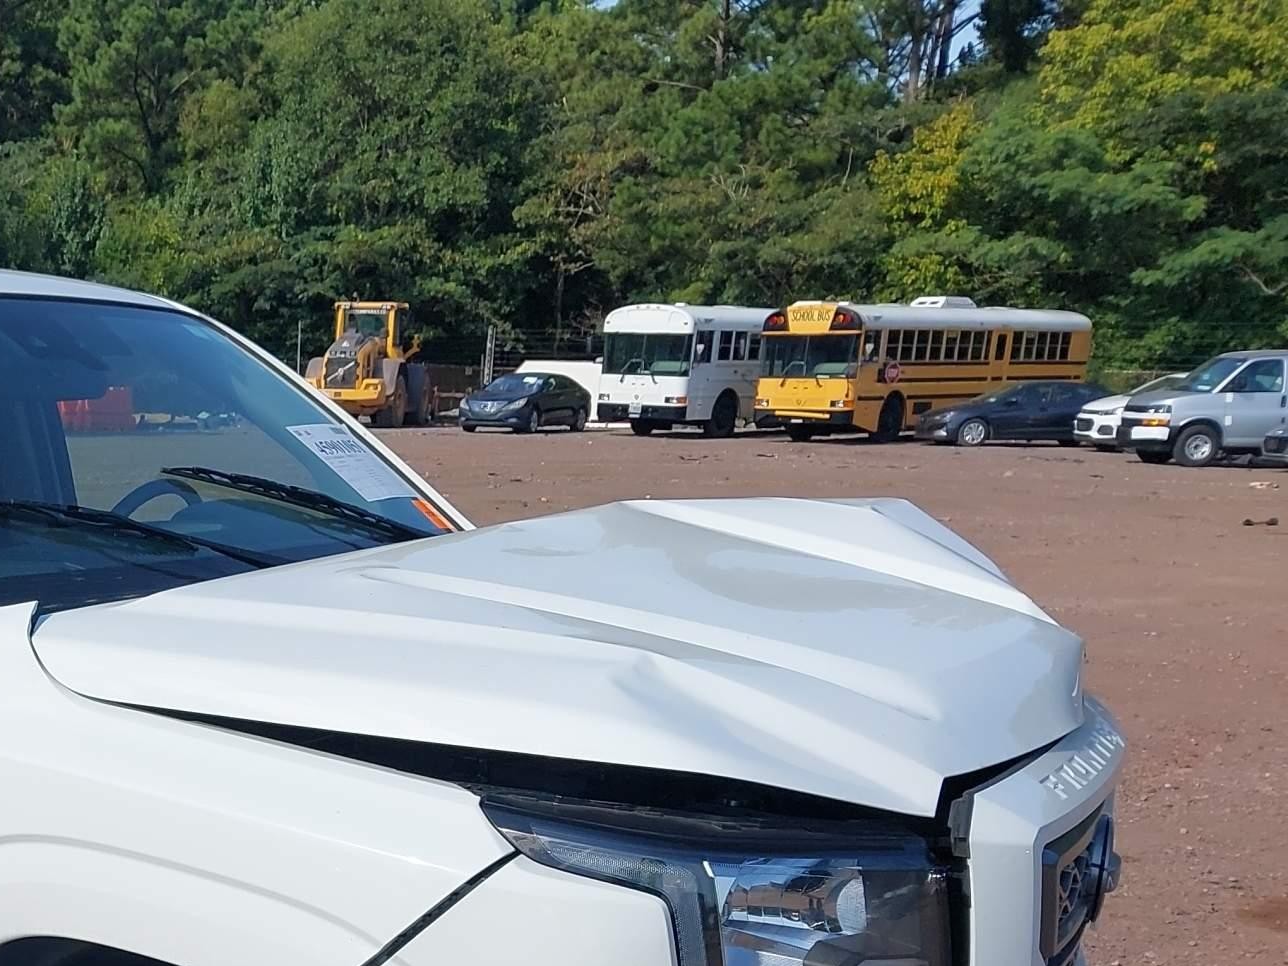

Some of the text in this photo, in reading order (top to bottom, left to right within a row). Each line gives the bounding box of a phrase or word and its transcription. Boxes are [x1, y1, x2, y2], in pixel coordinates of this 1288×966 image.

[792, 310, 831, 321] SCHOOL BUS
[314, 439, 367, 455] 45901051
